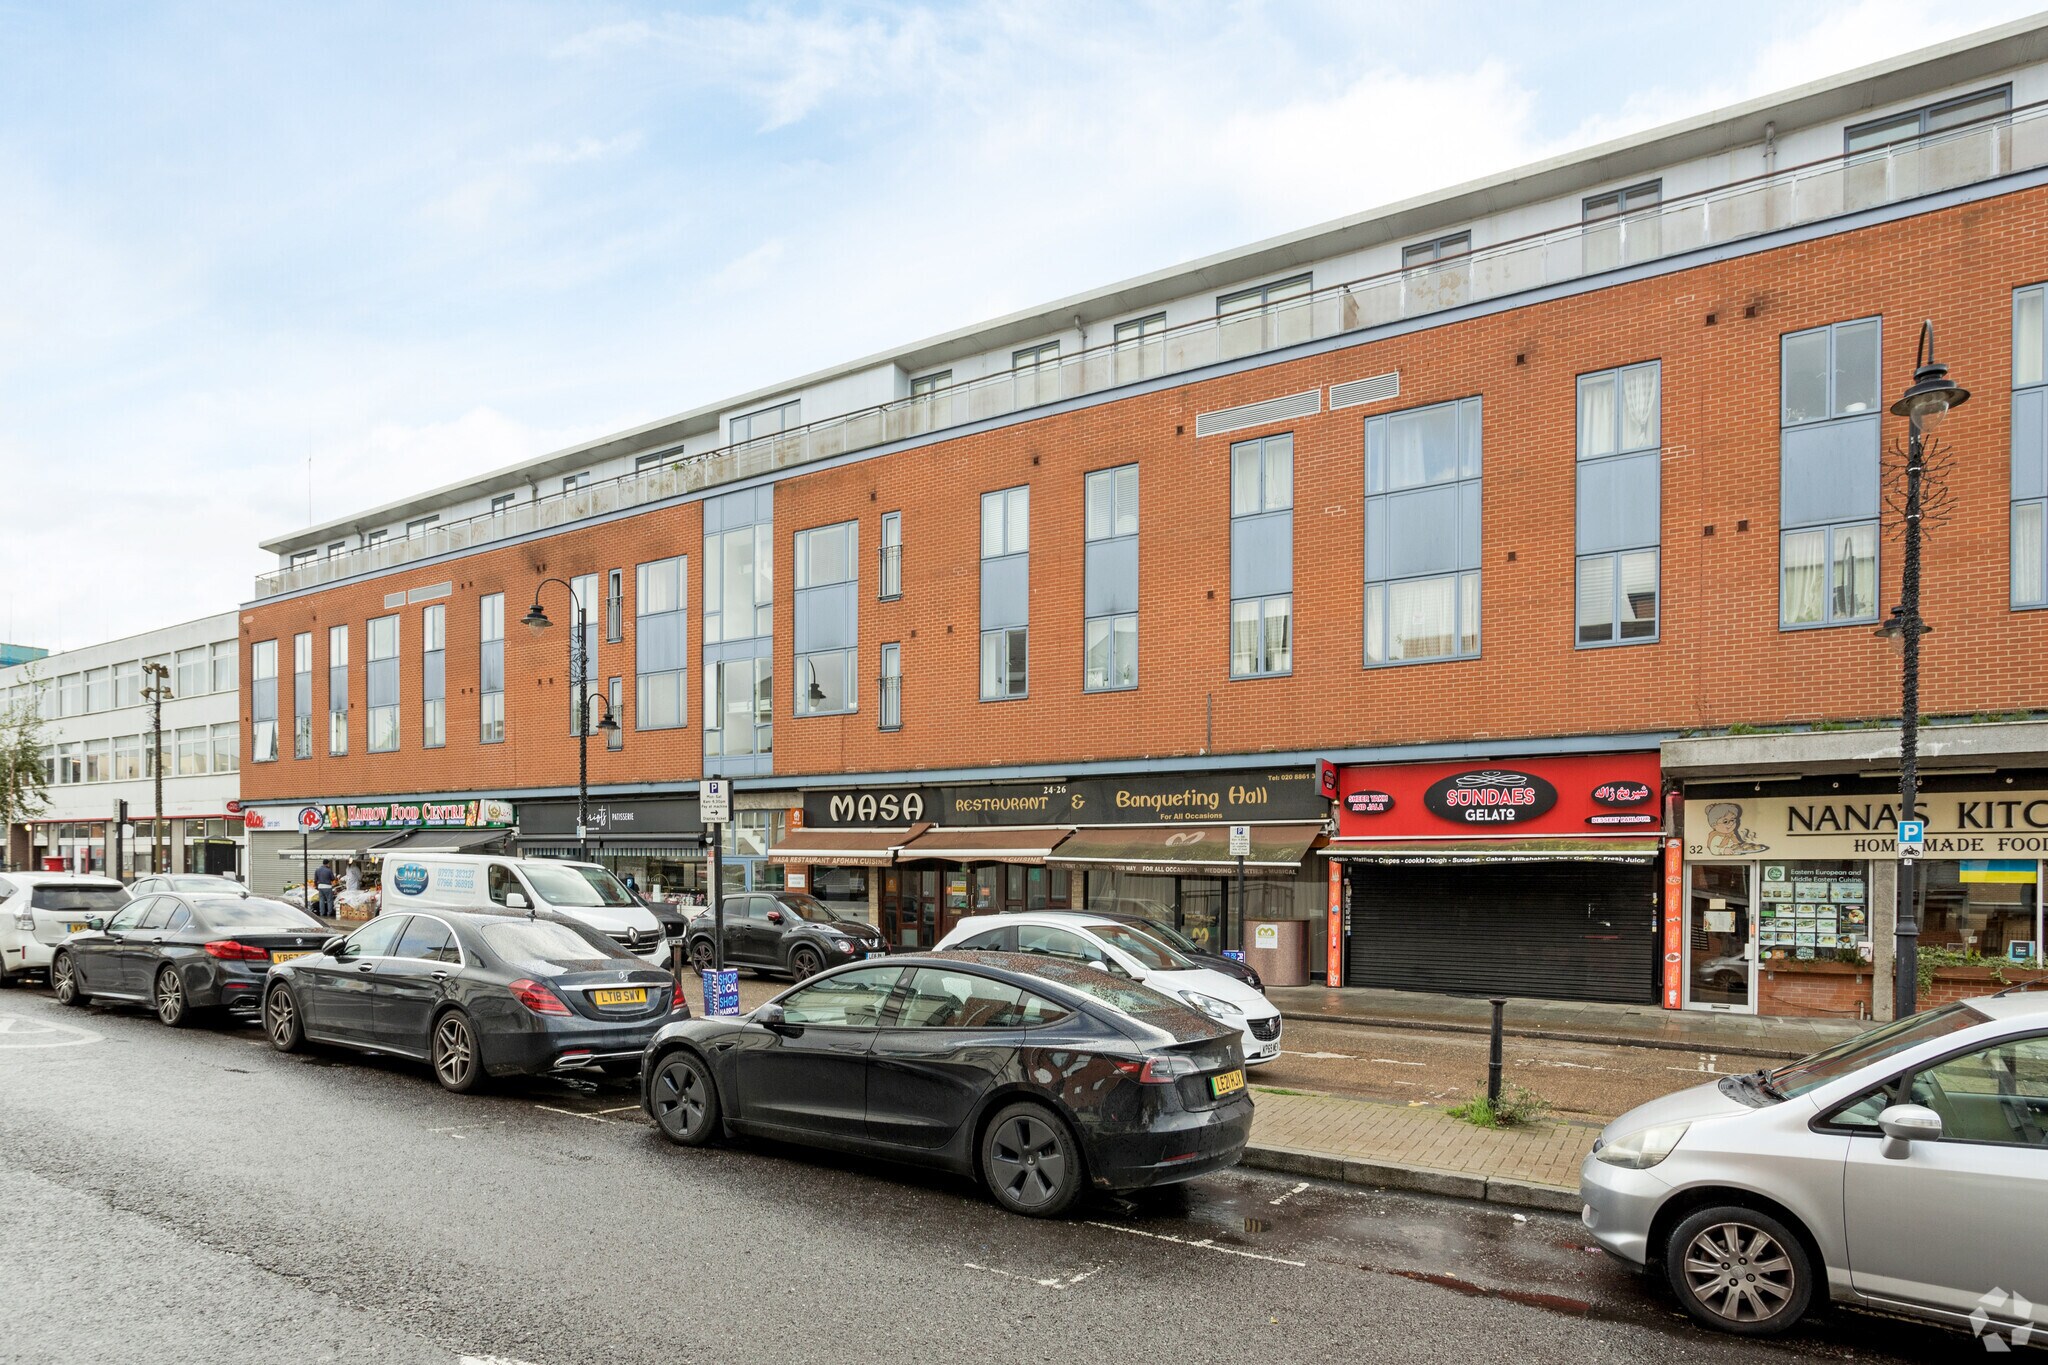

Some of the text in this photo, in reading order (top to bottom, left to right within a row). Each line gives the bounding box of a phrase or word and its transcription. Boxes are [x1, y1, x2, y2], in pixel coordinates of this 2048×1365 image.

[711, 783, 718, 794] P
[1043, 785, 1067, 795] 24-26
[1071, 794, 1086, 810] &
[1116, 785, 1268, 813] Banqueting Hall
[1348, 794, 1370, 803] SHEER
[1446, 787, 1536, 807] SUNDAES
[829, 792, 925, 822] MASA
[955, 796, 1049, 812] RESTAURANT
[1352, 803, 1384, 811] AND JALA
[347, 805, 389, 821] HARROW
[391, 803, 419, 820] FOOD
[422, 802, 466, 820] CENTRE
[611, 812, 635, 821] PATISSERIE
[1185, 812, 1223, 820] Occasions
[1465, 808, 1516, 821] GELATO
[1787, 802, 1930, 832] NANA'S
[1591, 816, 1621, 824] DESSERT
[1904, 824, 1919, 841] P
[1689, 845, 1703, 855] 32
[1854, 839, 1895, 853] HOM
[1923, 837, 1984, 852] MADE
[719, 973, 738, 985] SHOP
[719, 983, 738, 995] LOCAL
[601, 991, 622, 1002] LT18
[719, 995, 738, 1008] SHOP
[720, 1006, 739, 1016] HARROW
